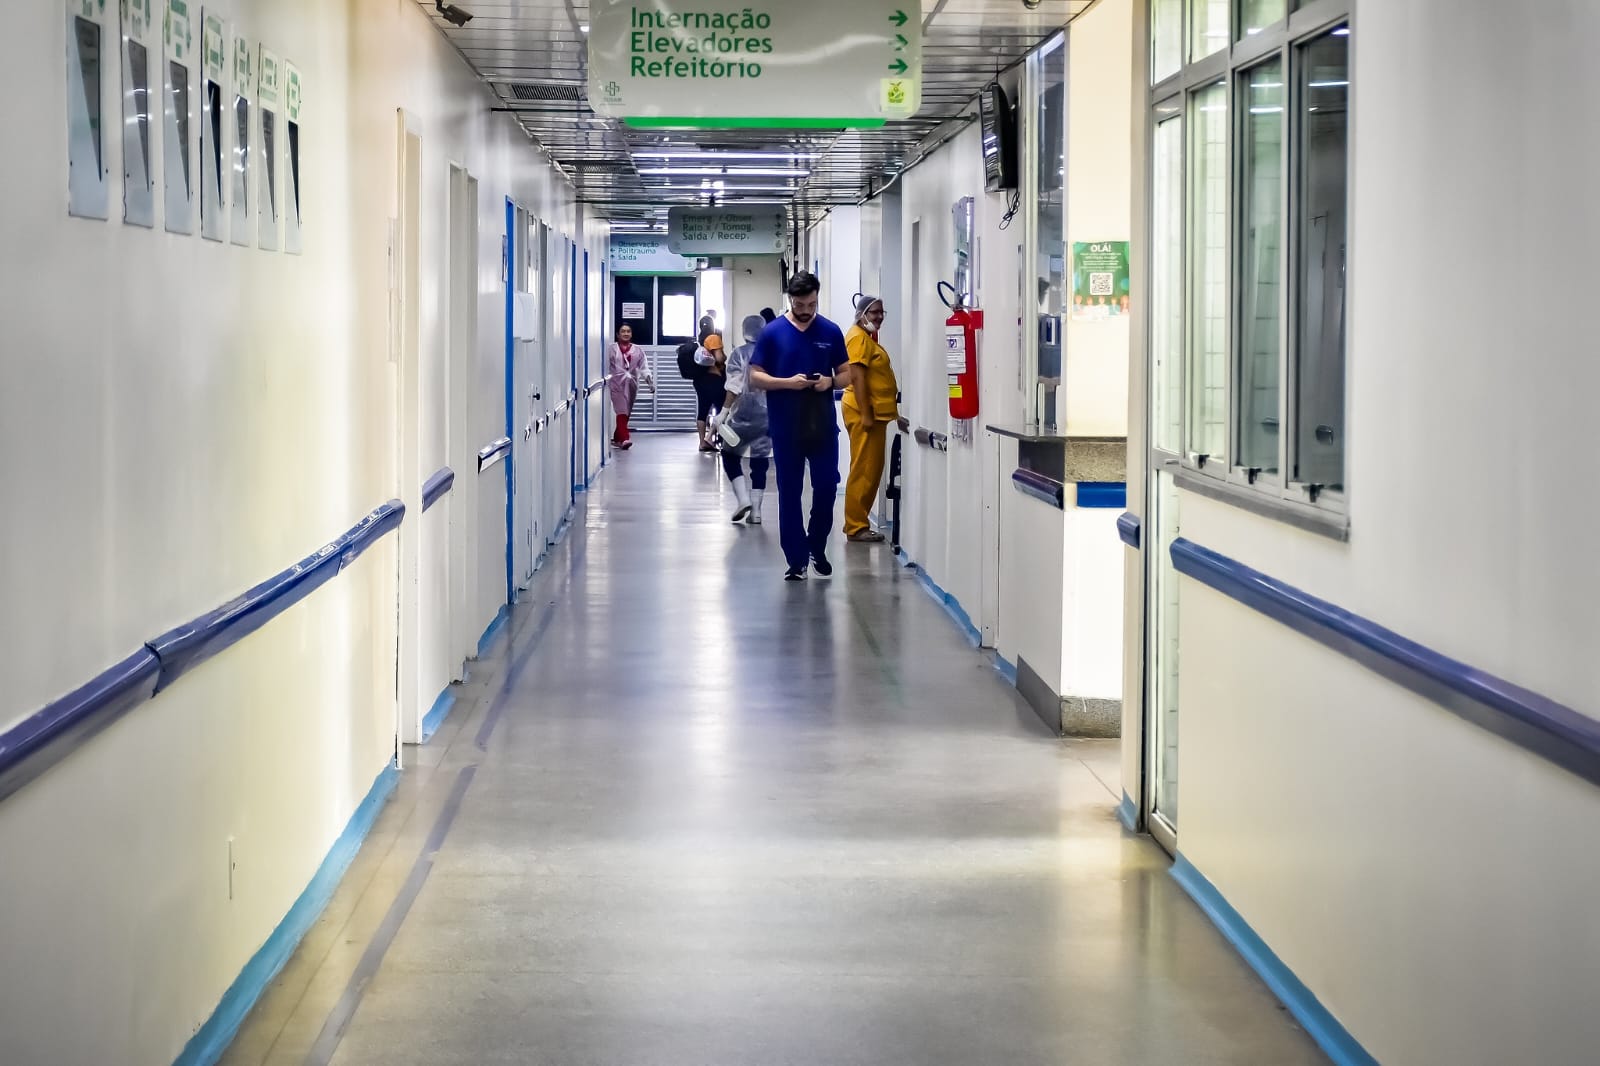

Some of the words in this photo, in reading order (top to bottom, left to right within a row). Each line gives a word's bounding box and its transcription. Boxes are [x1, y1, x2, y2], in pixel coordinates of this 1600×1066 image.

[631, 7, 771, 34] Internação
[631, 32, 773, 53] Elevadores
[631, 56, 761, 78] Refeitório
[718, 232, 750, 241] Recep.
[1090, 243, 1112, 253] OLÁ!
